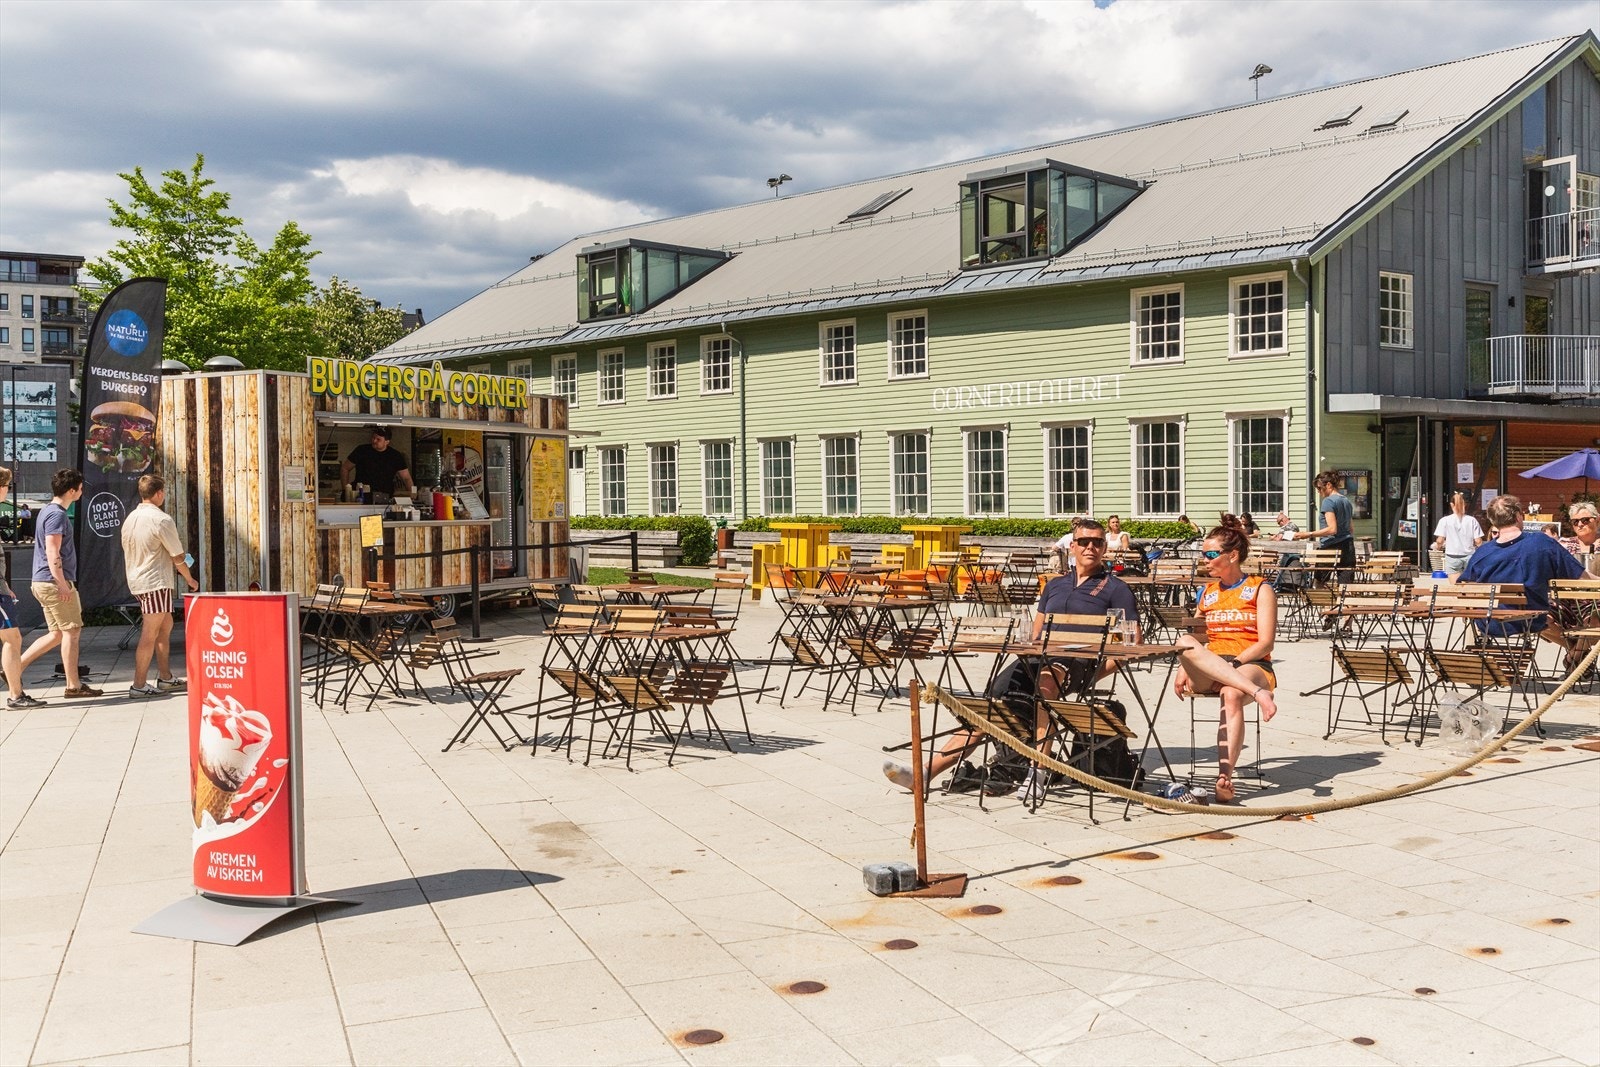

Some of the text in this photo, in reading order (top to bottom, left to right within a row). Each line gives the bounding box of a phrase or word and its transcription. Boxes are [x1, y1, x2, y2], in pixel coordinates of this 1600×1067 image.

[91, 366, 160, 384] VERDENS BESTE
[311, 358, 529, 410] BURGERS PÅ CORNER
[933, 374, 1125, 411] CORNERTEATERET
[92, 501, 119, 513] 100%
[93, 510, 119, 521] PLANT
[95, 518, 121, 530] BASED
[202, 650, 247, 664] HENNIG
[205, 665, 244, 679] OLSEN
[210, 851, 256, 868] KREMEN
[207, 865, 263, 882] AV ISKREM
